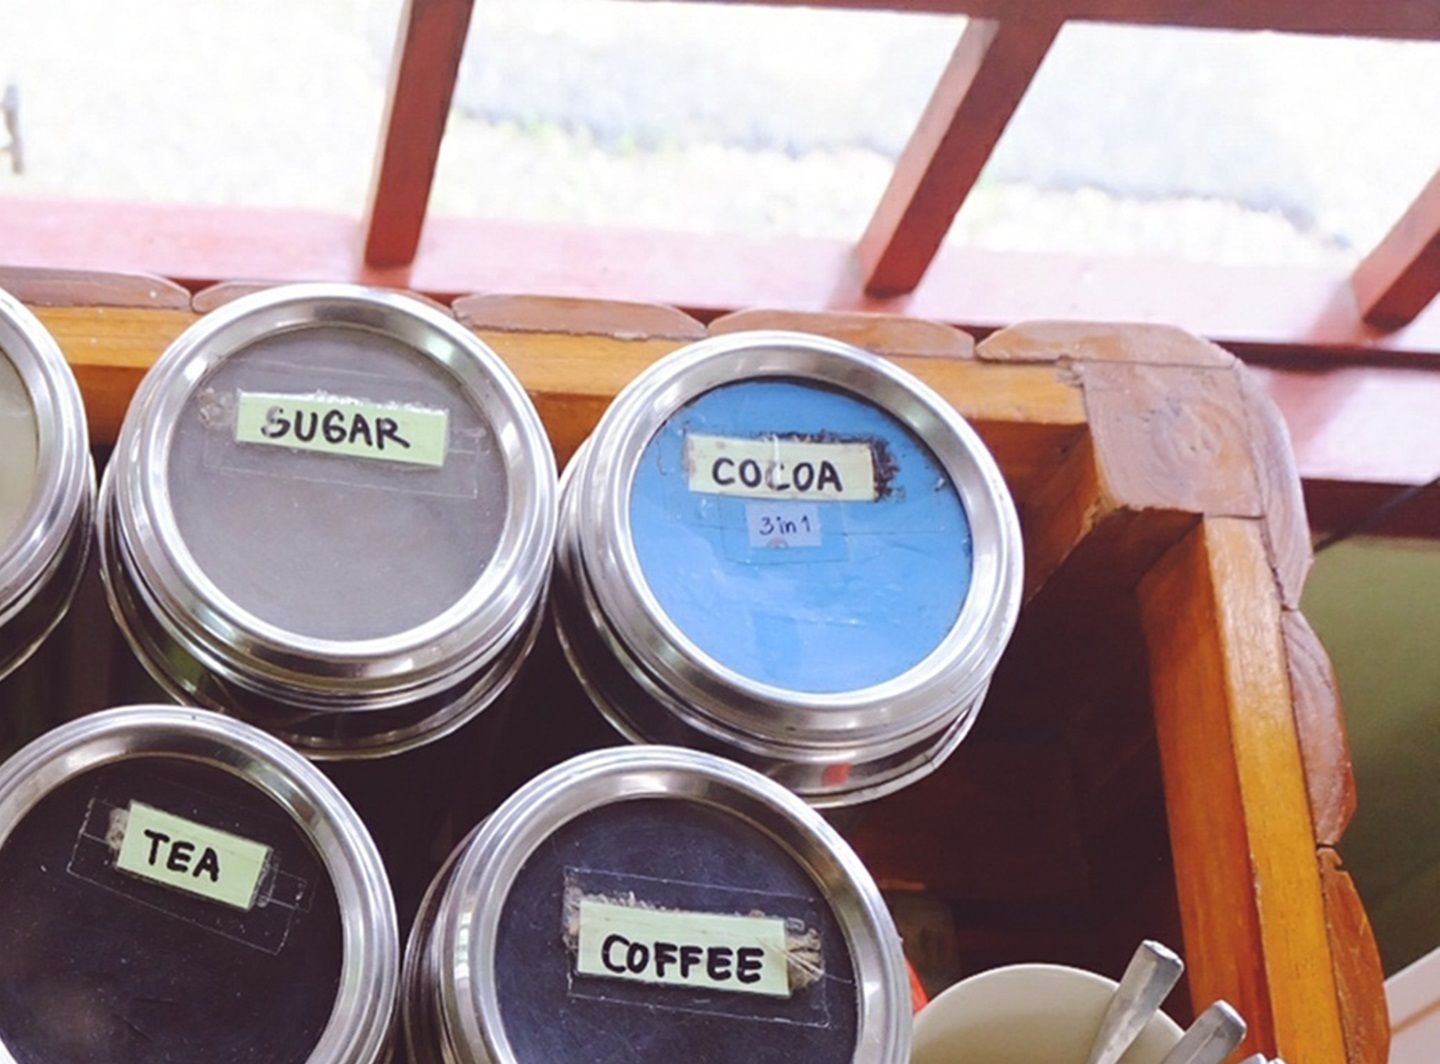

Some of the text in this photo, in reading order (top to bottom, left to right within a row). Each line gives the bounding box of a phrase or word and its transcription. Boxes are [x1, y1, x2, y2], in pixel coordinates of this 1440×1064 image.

[261, 406, 410, 450] SUGAR
[712, 457, 843, 492] COCOA
[144, 829, 220, 882] TEA
[601, 934, 764, 984] COFFEE
